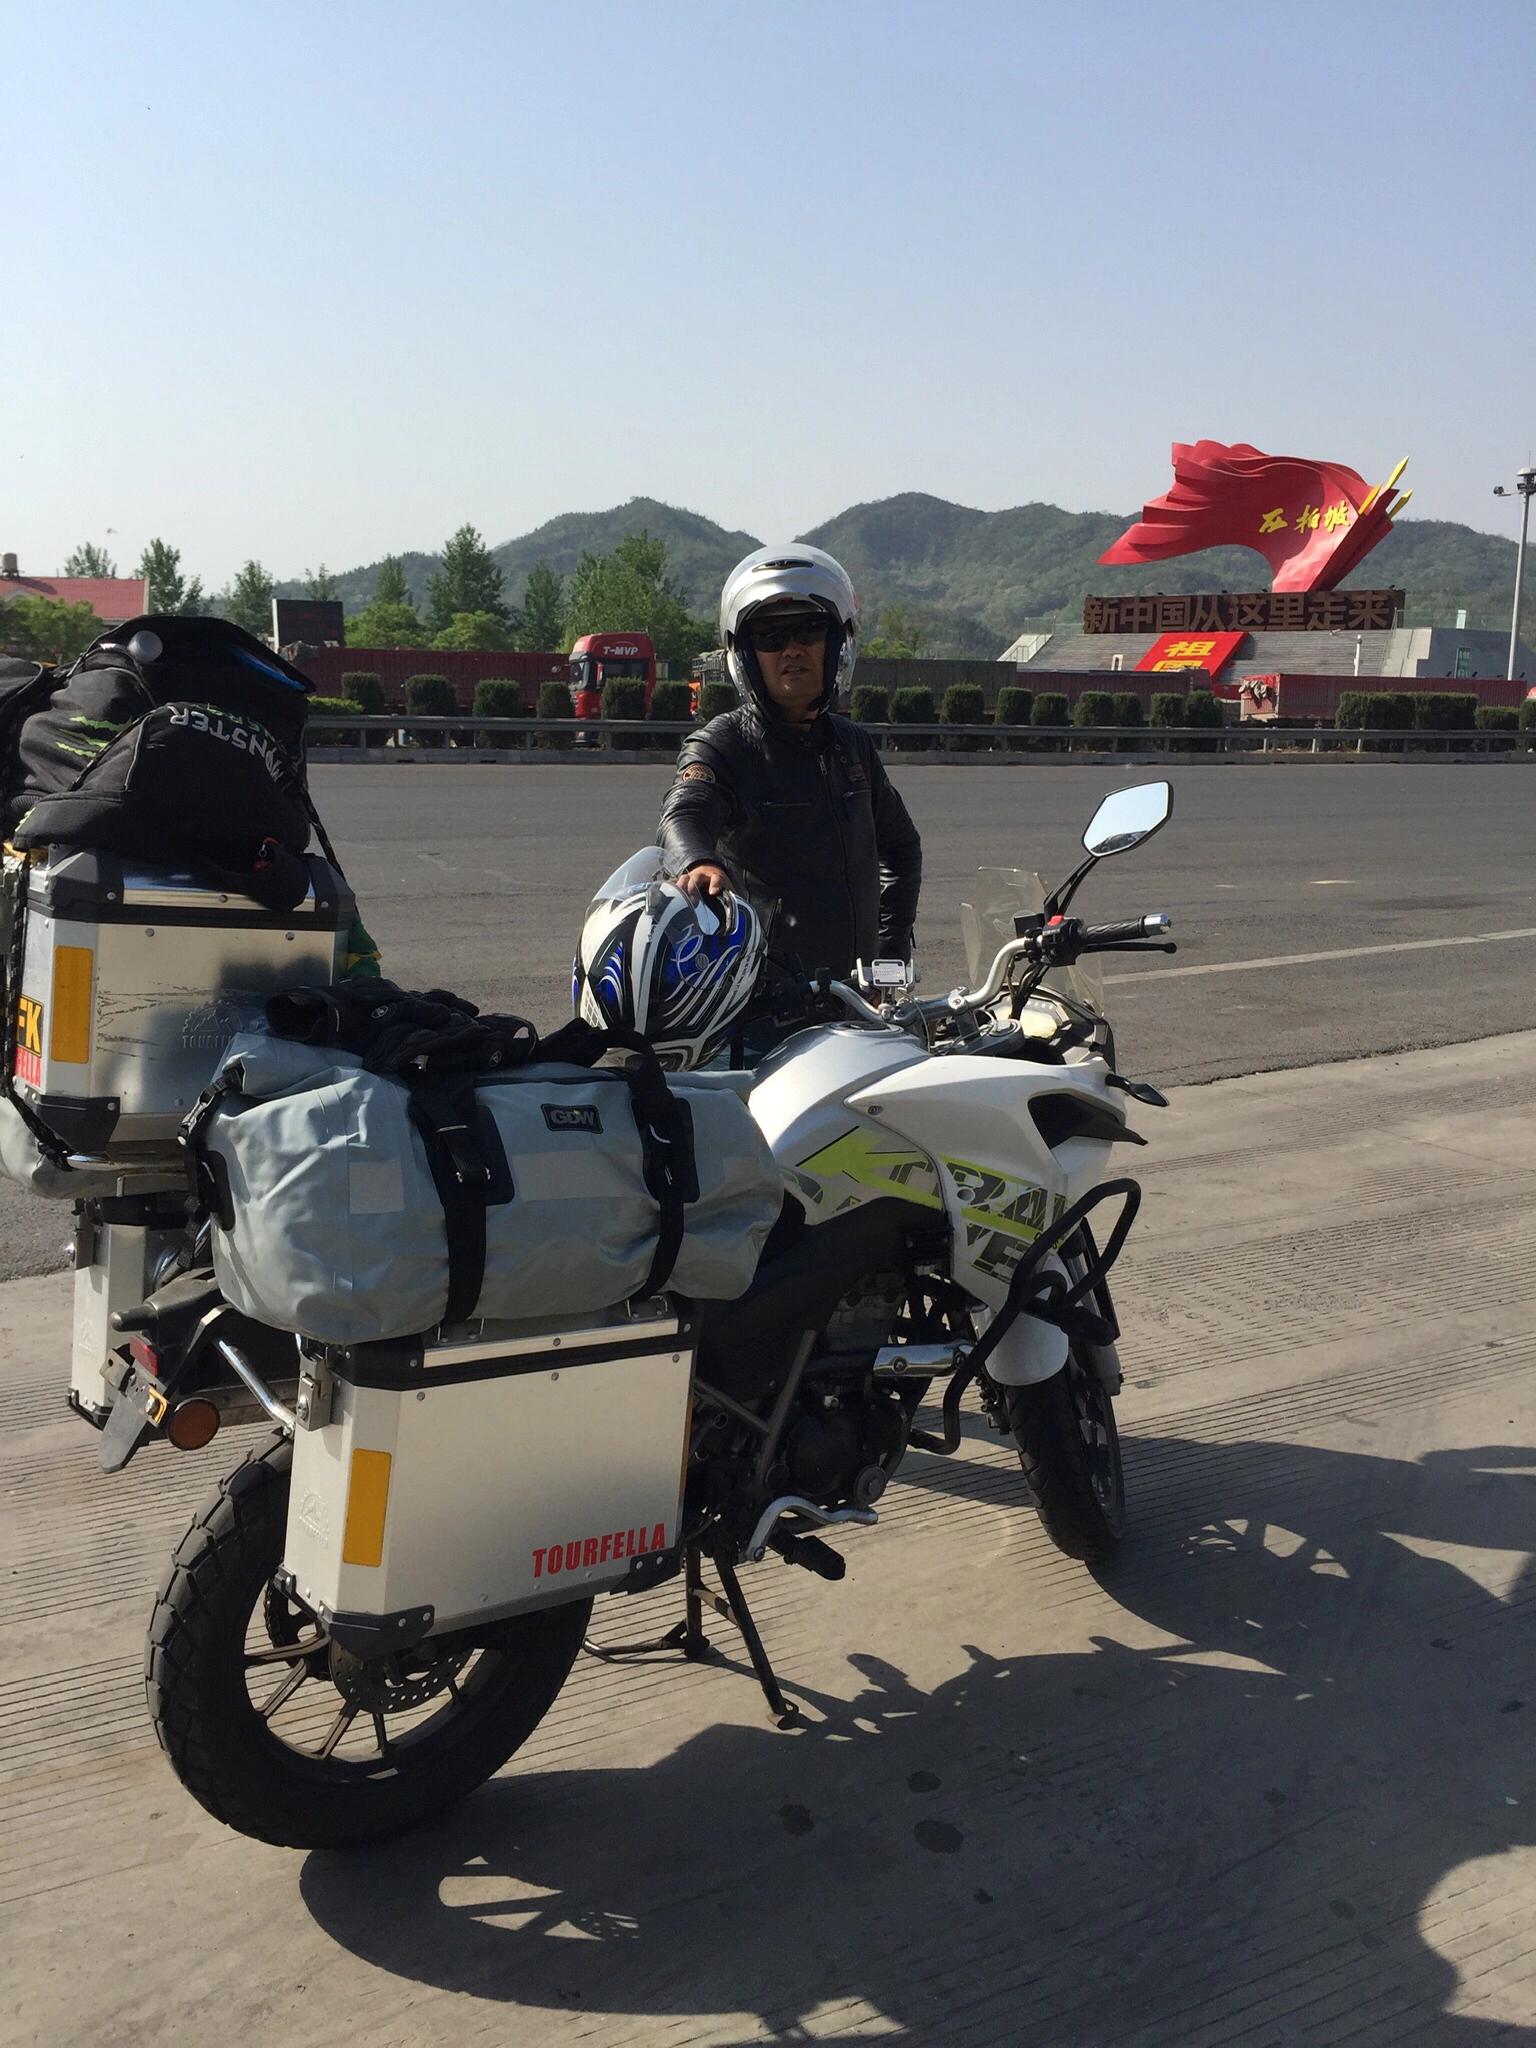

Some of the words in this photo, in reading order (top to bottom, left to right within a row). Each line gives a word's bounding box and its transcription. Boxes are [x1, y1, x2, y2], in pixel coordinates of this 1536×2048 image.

[1084, 592, 1391, 633] 新中国从这里走来
[603, 646, 639, 656] T-MVP
[167, 705, 285, 783] MONSTER
[532, 1522, 666, 1579] TOURFELLA
